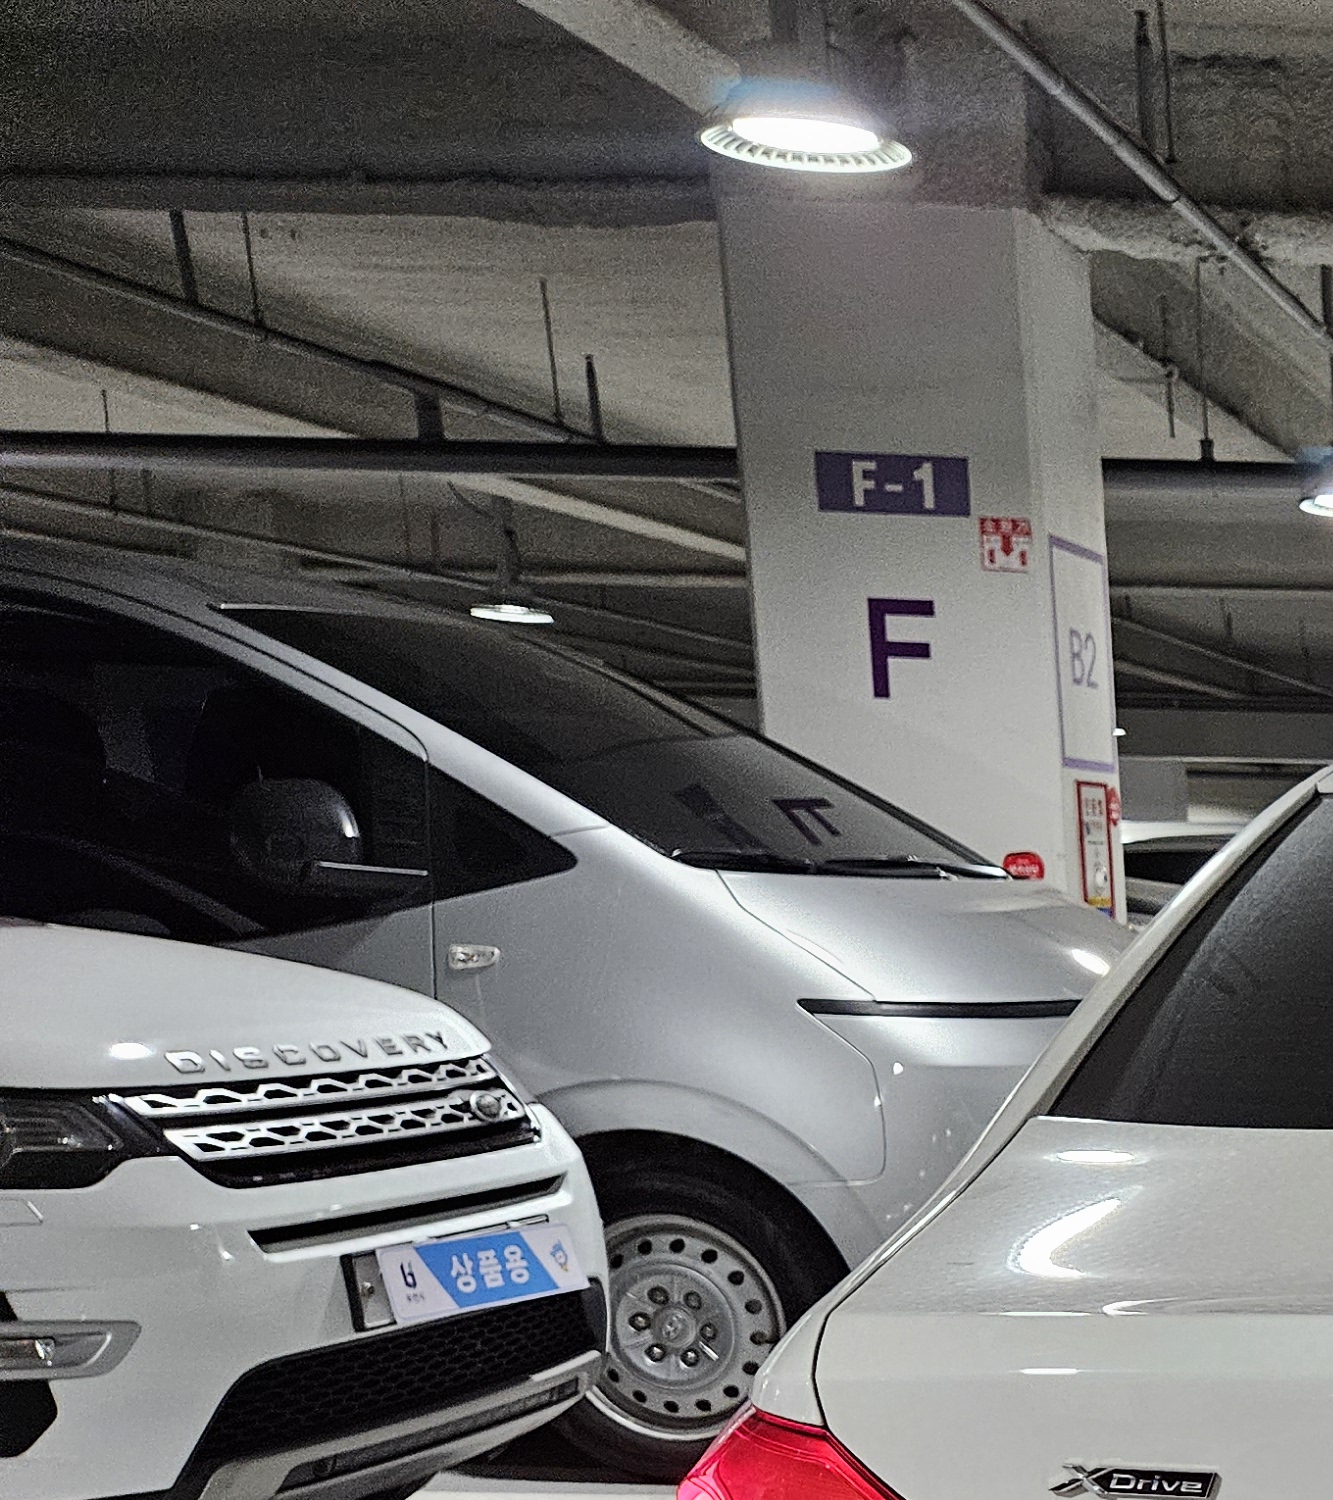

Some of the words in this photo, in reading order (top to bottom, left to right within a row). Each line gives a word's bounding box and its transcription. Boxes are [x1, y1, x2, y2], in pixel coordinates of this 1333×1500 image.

[851, 459, 936, 509] F-1
[867, 597, 936, 698] F
[1069, 628, 1100, 690] B2
[164, 1029, 450, 1075] DISCOVERY
[450, 1244, 531, 1294] 상품용
